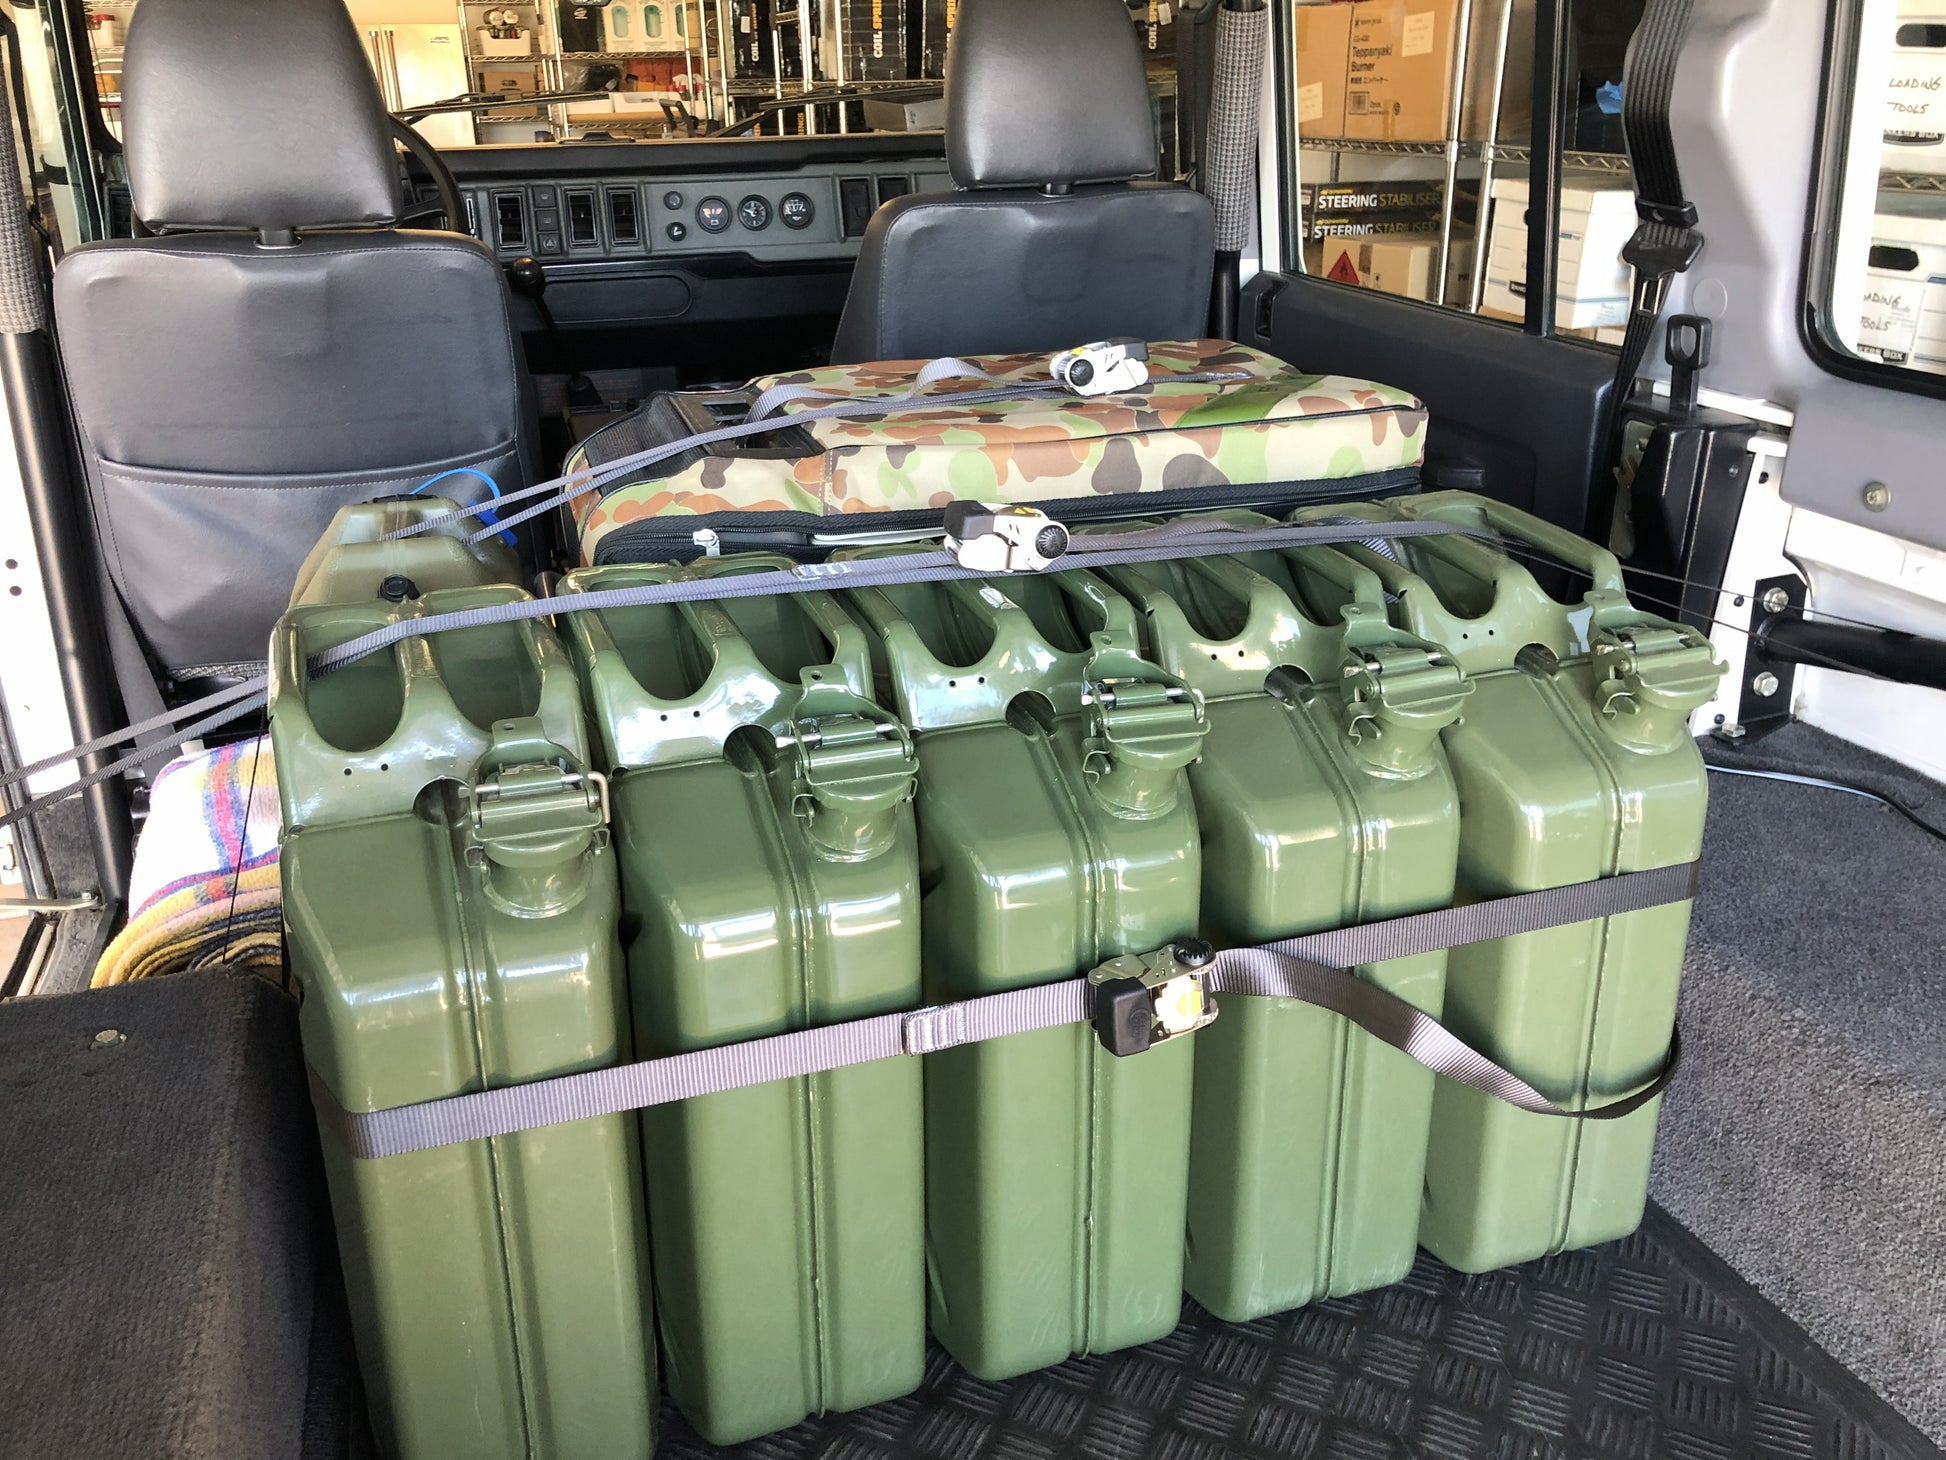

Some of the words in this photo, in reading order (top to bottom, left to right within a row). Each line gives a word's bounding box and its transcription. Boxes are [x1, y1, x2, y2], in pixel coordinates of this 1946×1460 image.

[872, 0, 882, 29] SPRI
[873, 31, 883, 58] COIL
[1148, 23, 1157, 50] COIL
[1888, 77, 1942, 91] LOADING
[1887, 102, 1930, 114] TOOLS
[1319, 194, 1378, 209] STEERING
[1379, 193, 1442, 207] STABILISER
[1314, 223, 1374, 239] STEERING
[1375, 221, 1438, 235] STABILISER
[1863, 292, 1902, 307] ADING
